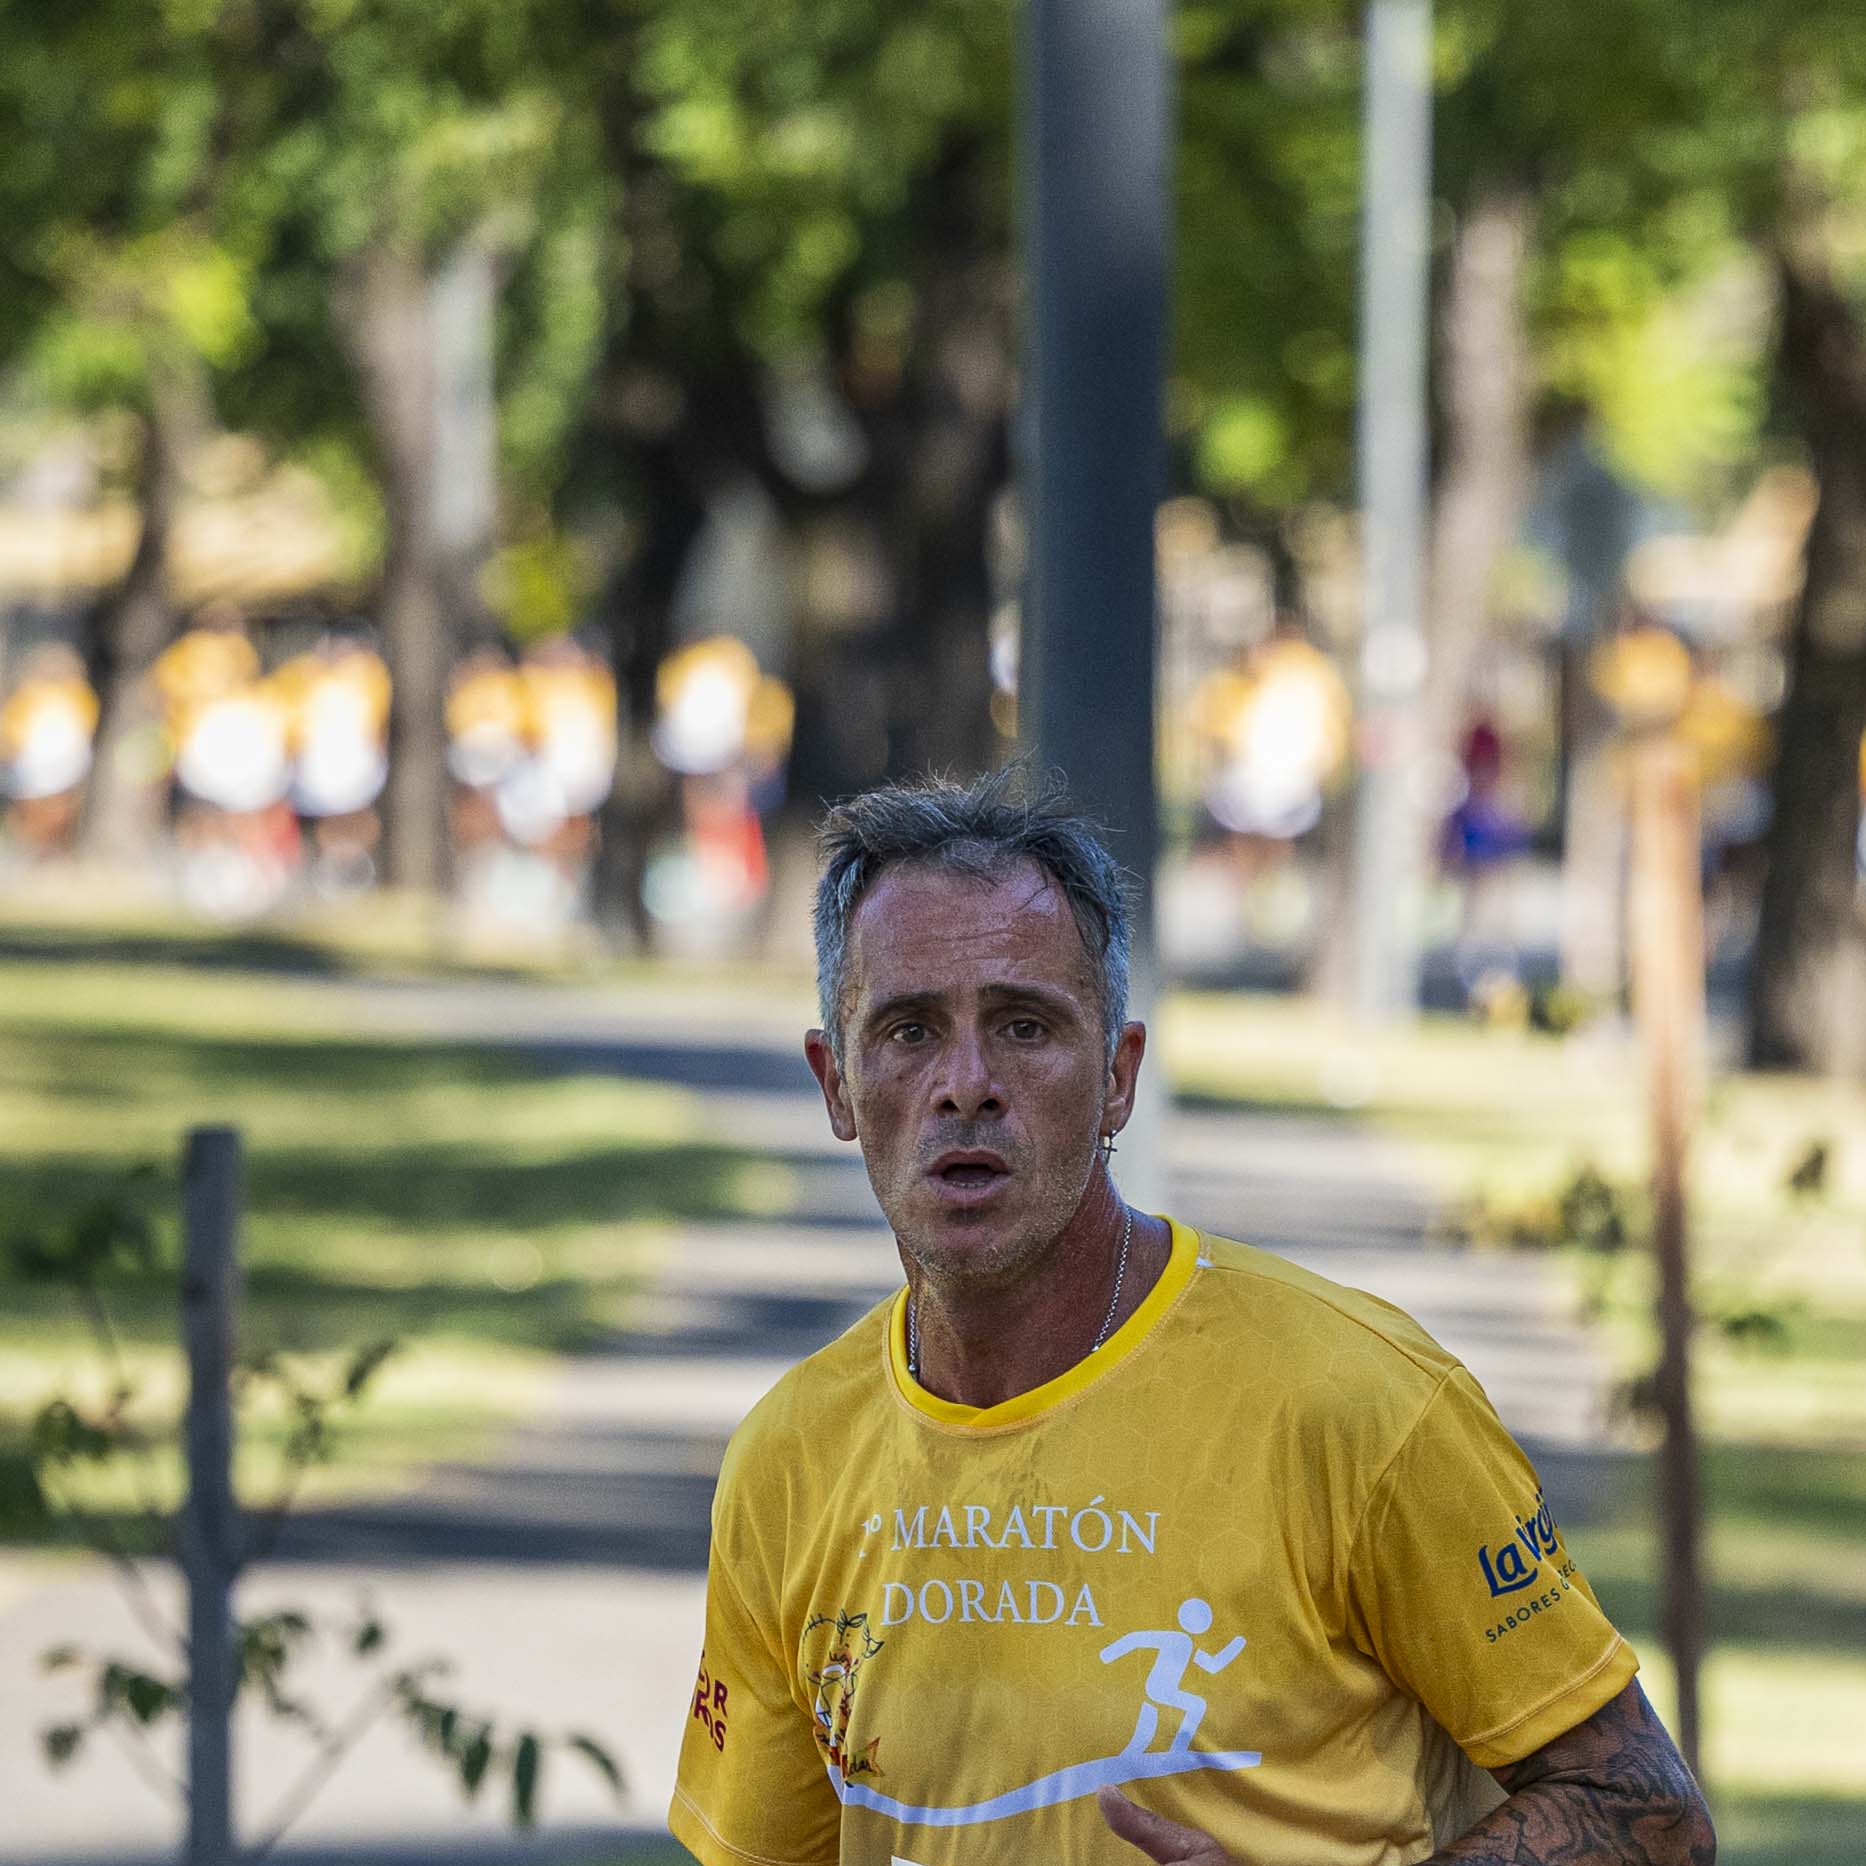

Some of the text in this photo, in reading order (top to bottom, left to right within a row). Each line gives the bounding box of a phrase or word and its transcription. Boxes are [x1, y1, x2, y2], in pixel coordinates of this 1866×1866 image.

[891, 1494, 1161, 1554] MARATÓN
[1478, 1542, 1539, 1598] La
[880, 1579, 1105, 1627] DORADA
[1485, 1588, 1562, 1643] SABORES
